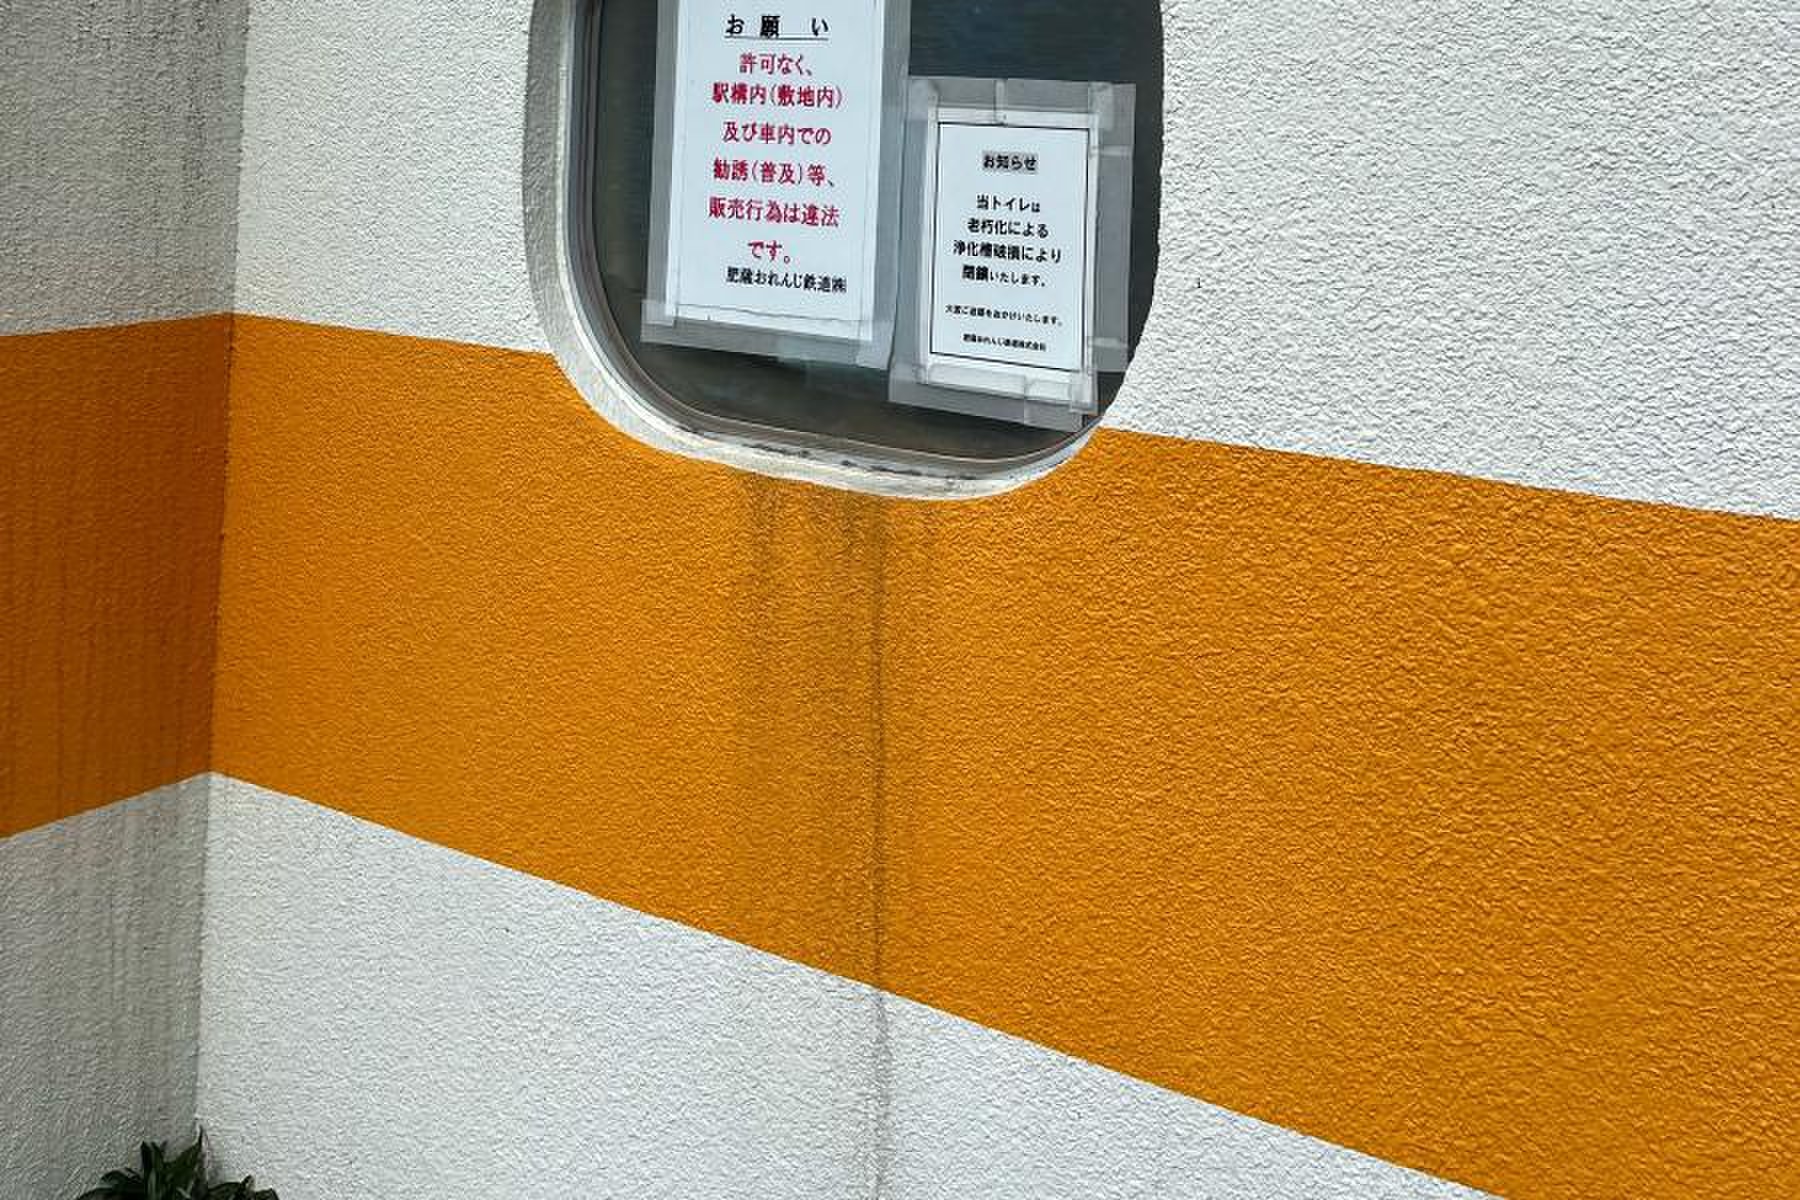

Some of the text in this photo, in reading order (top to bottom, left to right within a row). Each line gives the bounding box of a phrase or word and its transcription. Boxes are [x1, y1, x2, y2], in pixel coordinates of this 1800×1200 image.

[739, 52, 813, 77] 許可なく、
[711, 81, 843, 109] 駅構内(敷地内)
[722, 121, 832, 146] 及び車内での
[712, 157, 835, 188] 勧誘(普及)等、
[982, 154, 1038, 172] お知らせ
[708, 196, 840, 228] 販売行為は違法
[976, 194, 1041, 213] 当トイレは
[966, 217, 1049, 239] 老朽化による
[747, 239, 791, 265] です。
[952, 239, 1062, 264] 浄化槽破損により
[961, 264, 1046, 288] 閉鎖いたします。
